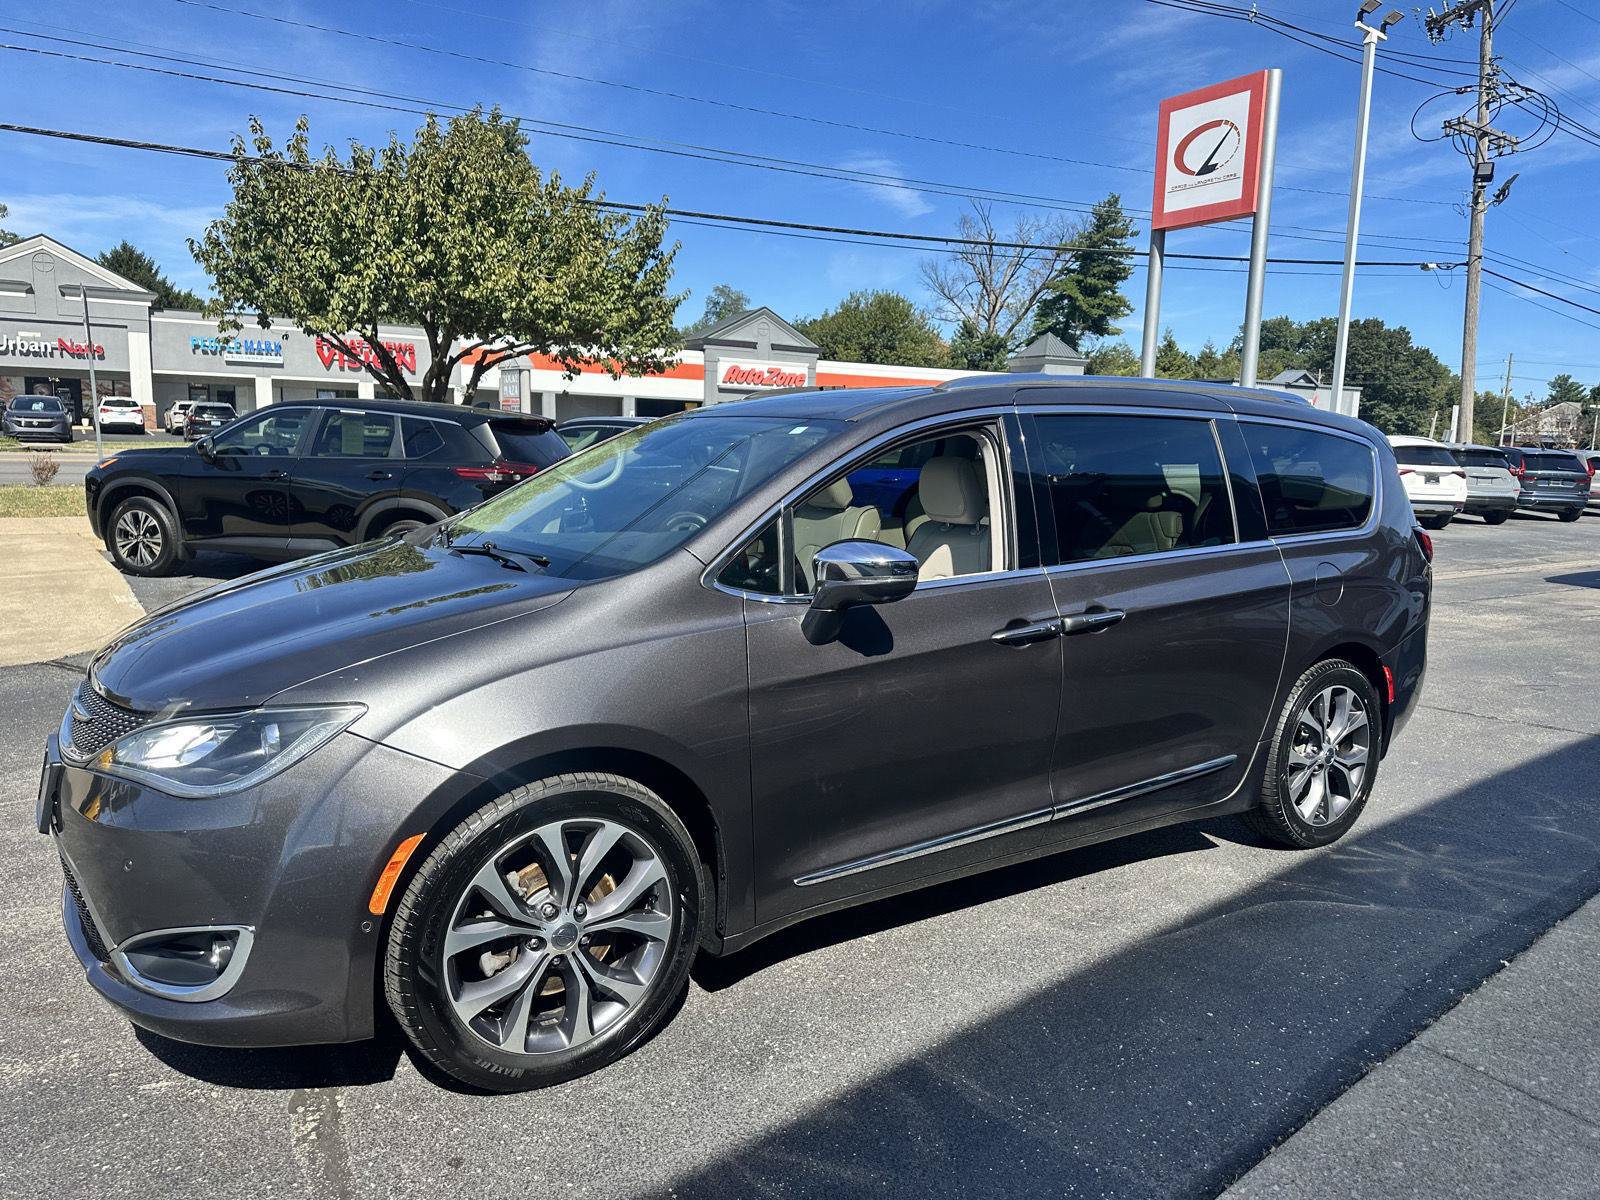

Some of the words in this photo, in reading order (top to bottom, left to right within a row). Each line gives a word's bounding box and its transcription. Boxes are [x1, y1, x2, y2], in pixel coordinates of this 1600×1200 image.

[191, 336, 241, 352] PEOLE
[244, 339, 282, 354] MARK
[723, 365, 806, 387] AutoZone
